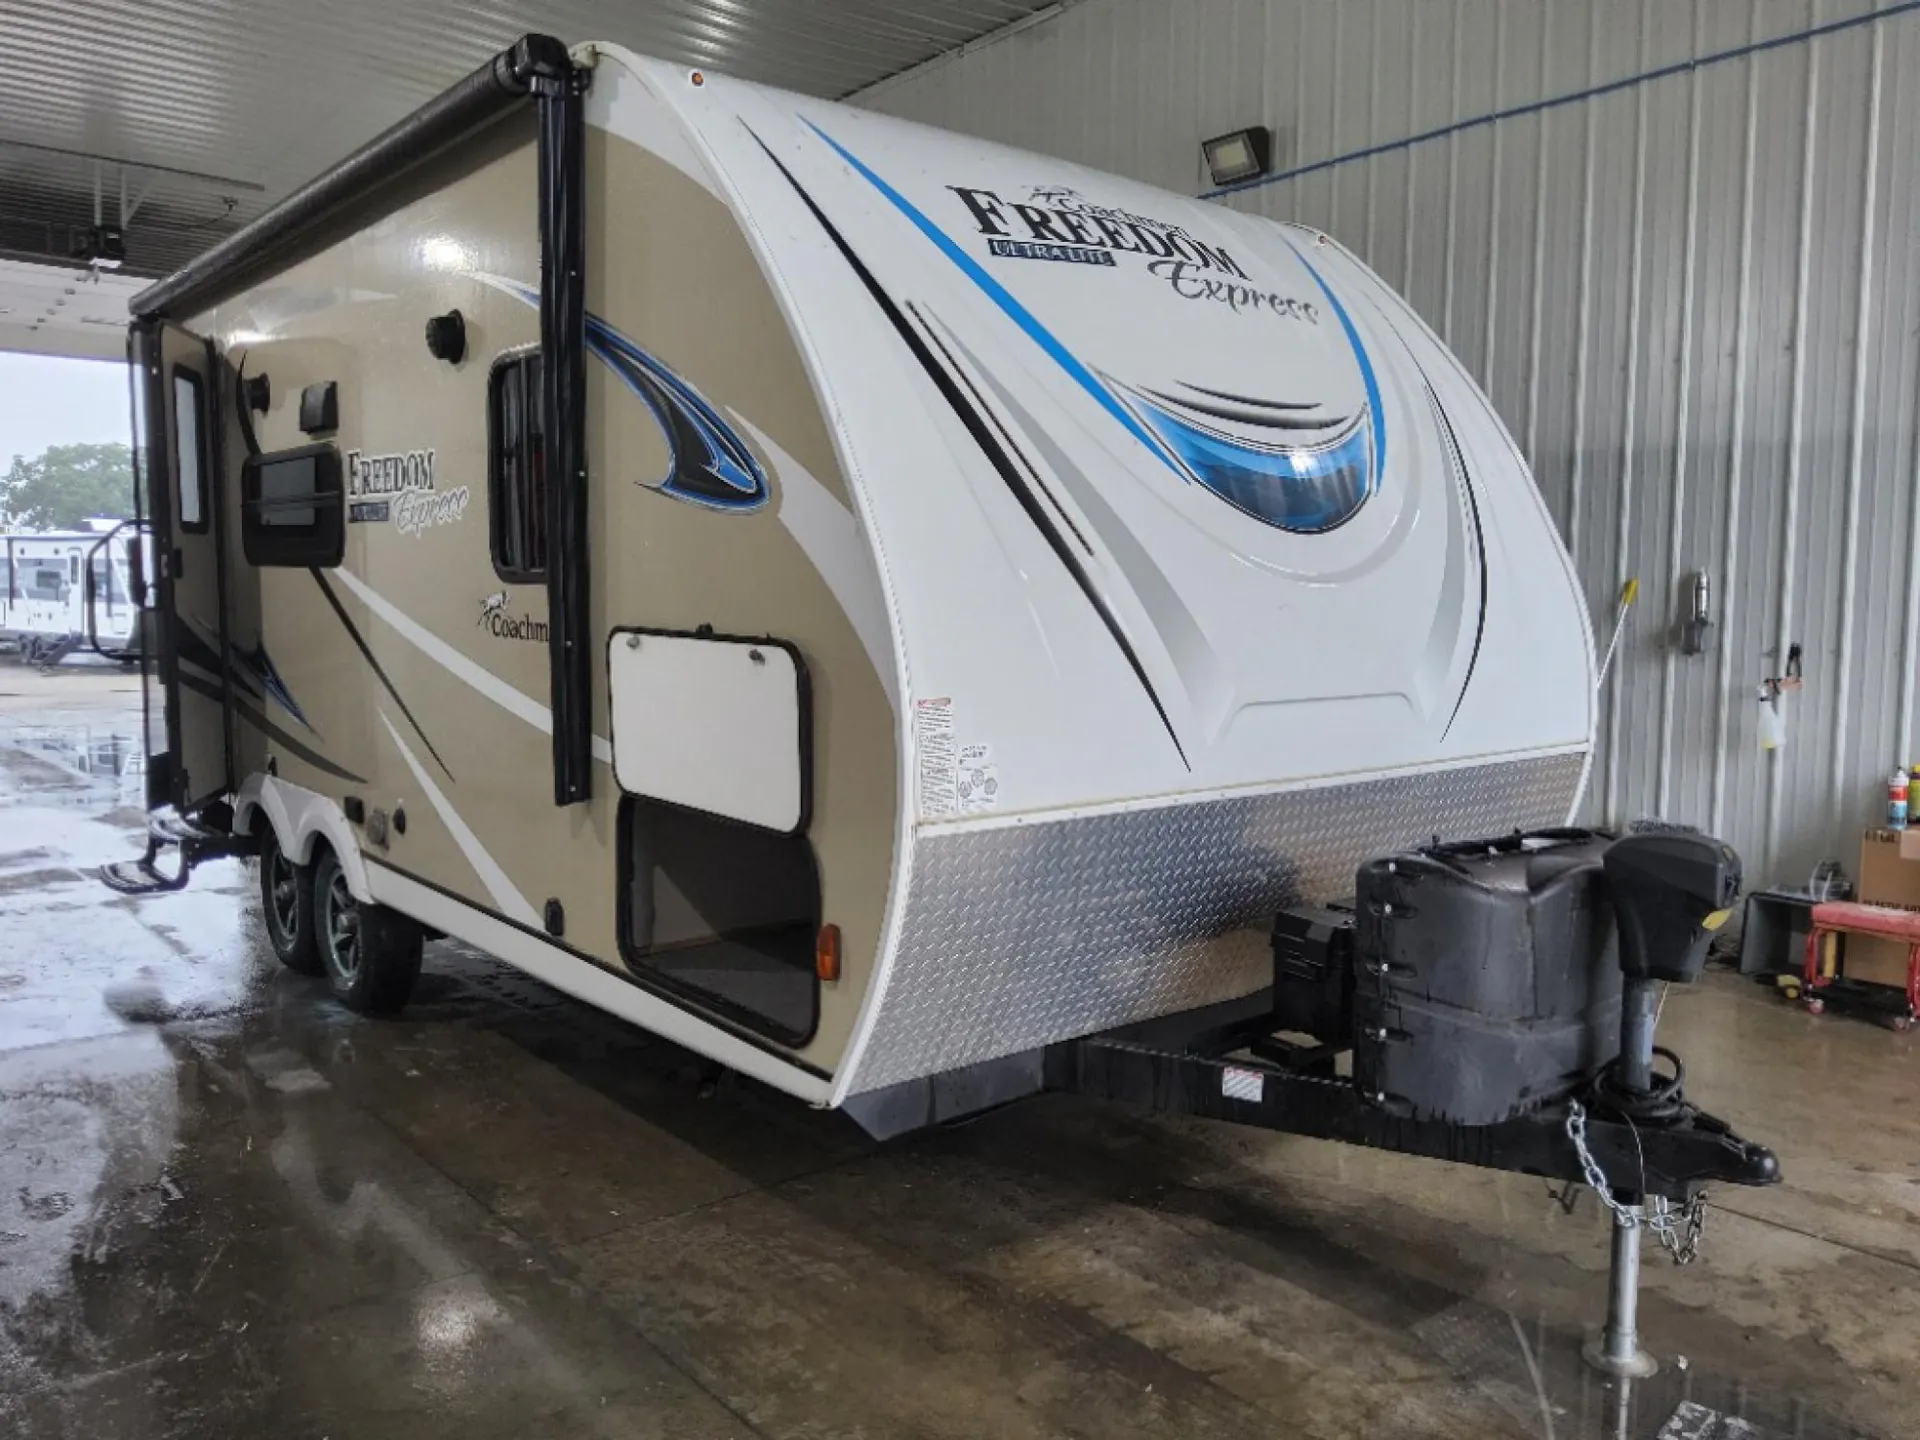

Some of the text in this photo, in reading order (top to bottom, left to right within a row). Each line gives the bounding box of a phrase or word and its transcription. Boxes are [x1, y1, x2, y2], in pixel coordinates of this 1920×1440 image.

[945, 185, 1252, 281] FREEDOM
[1147, 260, 1318, 326] Express
[348, 449, 435, 497] FREEDOM
[490, 613, 549, 642] Coachm
